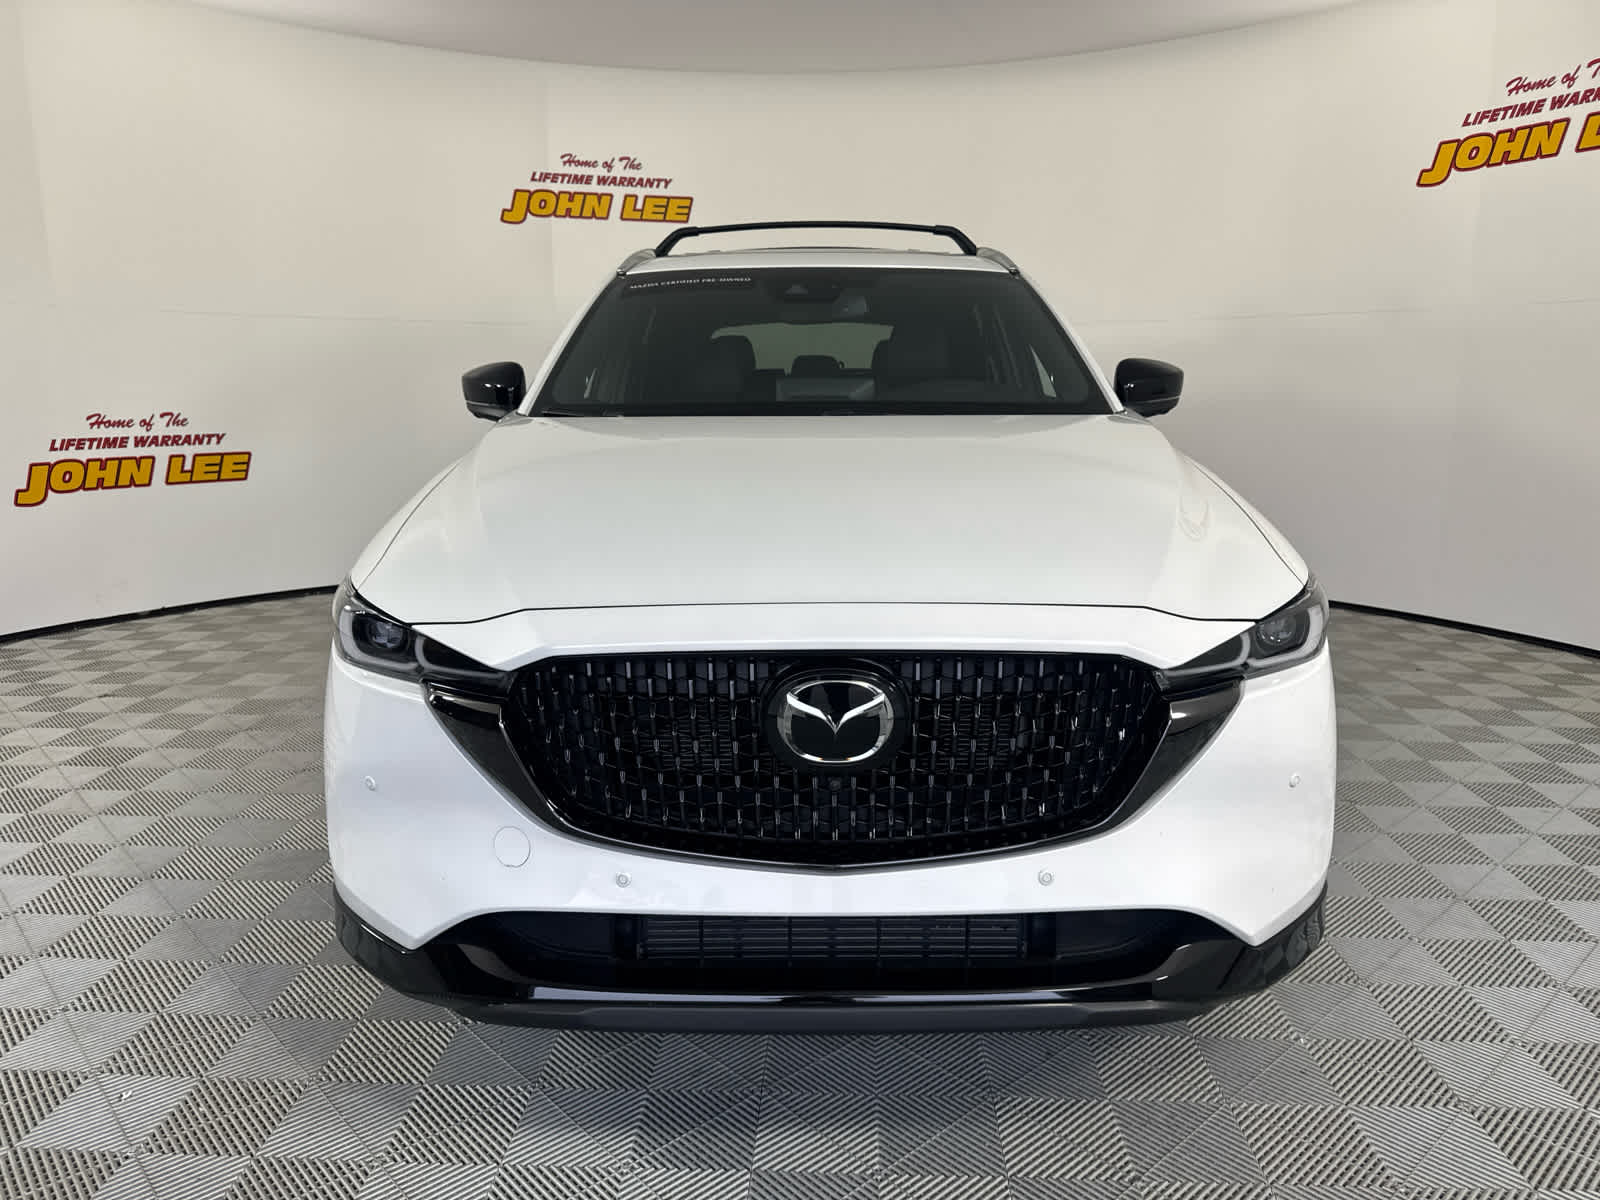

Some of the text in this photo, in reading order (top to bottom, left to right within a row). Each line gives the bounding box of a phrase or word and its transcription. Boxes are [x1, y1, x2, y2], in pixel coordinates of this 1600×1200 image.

[1506, 76, 1557, 97] Home
[1561, 64, 1582, 89] of
[1461, 98, 1548, 128] LIFETIME
[560, 153, 643, 172] Home of The
[1415, 116, 1571, 188] JOHN
[530, 171, 672, 189] LIFETIME WARRANTY
[499, 188, 694, 225] JOHN LEE
[86, 411, 189, 432] Home of The
[49, 433, 226, 452] LIFETIME WARRANTY
[14, 451, 252, 508] JOHN LEE
